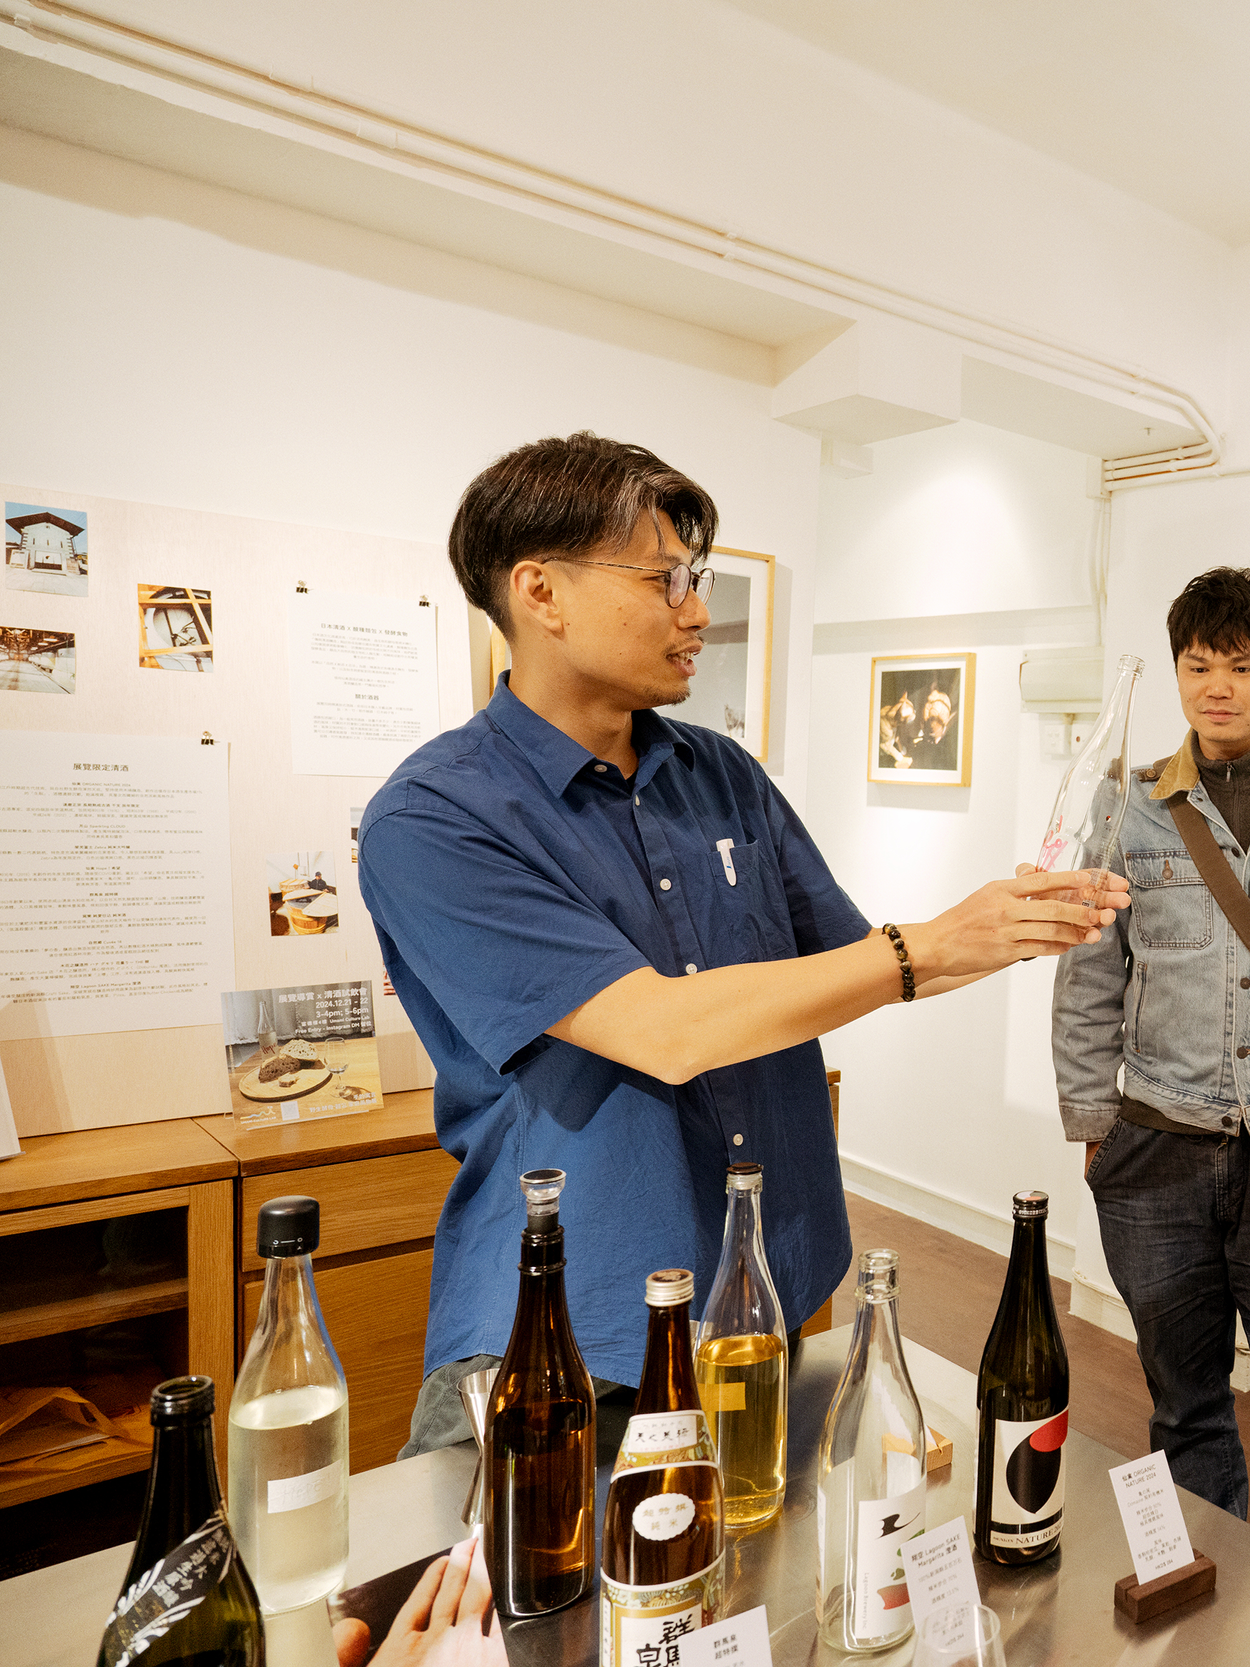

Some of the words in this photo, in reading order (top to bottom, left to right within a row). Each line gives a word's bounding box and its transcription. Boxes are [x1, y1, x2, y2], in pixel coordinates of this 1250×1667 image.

[73, 763, 129, 772] 展覽限定清酒
[278, 992, 315, 1003] 展覽導賞
[324, 987, 367, 999] 清酒試飲會
[315, 999, 352, 1009] 2024.12.21
[315, 1010, 343, 1020] 3-4pm;
[345, 1008, 369, 1017] 5-6pm
[326, 1024, 351, 1032] Instagram
[1133, 1464, 1156, 1477] ORGANIC
[1125, 1477, 1145, 1489] NATURE
[1146, 1473, 1157, 1482] 2024
[1015, 1529, 1054, 1545] NATURE
[925, 1543, 945, 1557] Lagoon
[946, 1534, 961, 1546] SAKE
[918, 1553, 945, 1569] Margarita
